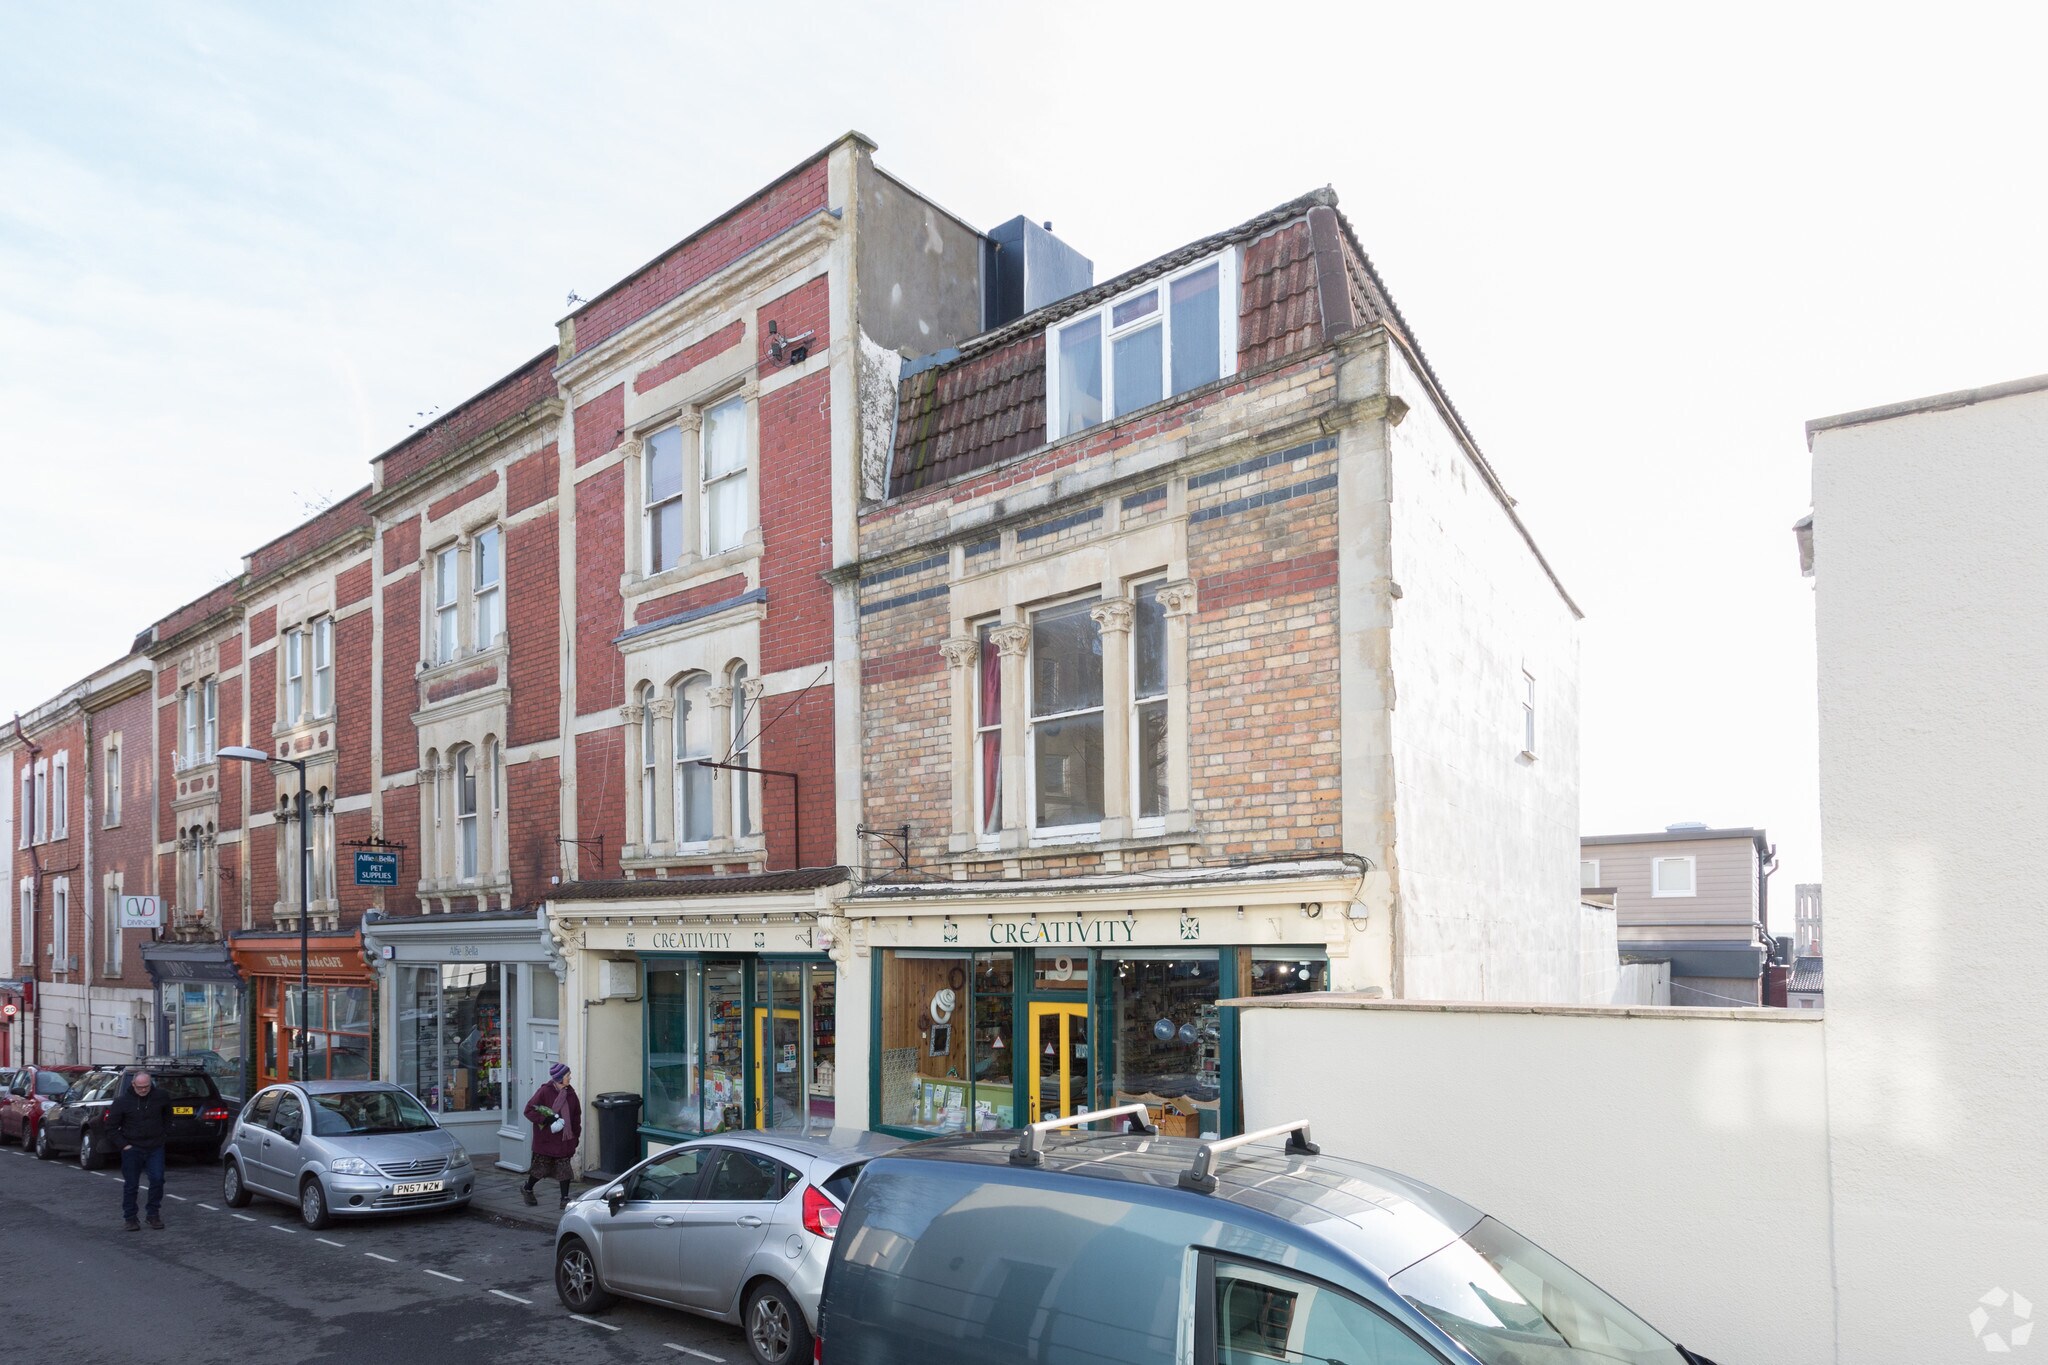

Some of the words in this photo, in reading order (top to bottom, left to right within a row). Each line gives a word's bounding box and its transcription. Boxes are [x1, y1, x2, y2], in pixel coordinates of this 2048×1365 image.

[378, 855, 395, 863] Bella
[370, 864, 383, 872] PET
[361, 871, 392, 879] SUPPLIES
[990, 916, 1139, 944] CREATIVITY
[653, 931, 732, 948] CREATIVITY
[267, 956, 281, 967] THE
[280, 954, 324, 968] Marmlade
[323, 956, 343, 968] CAFE
[1055, 954, 1073, 981] 9
[397, 1184, 421, 1193] PN57
[423, 1182, 440, 1191] WZW
